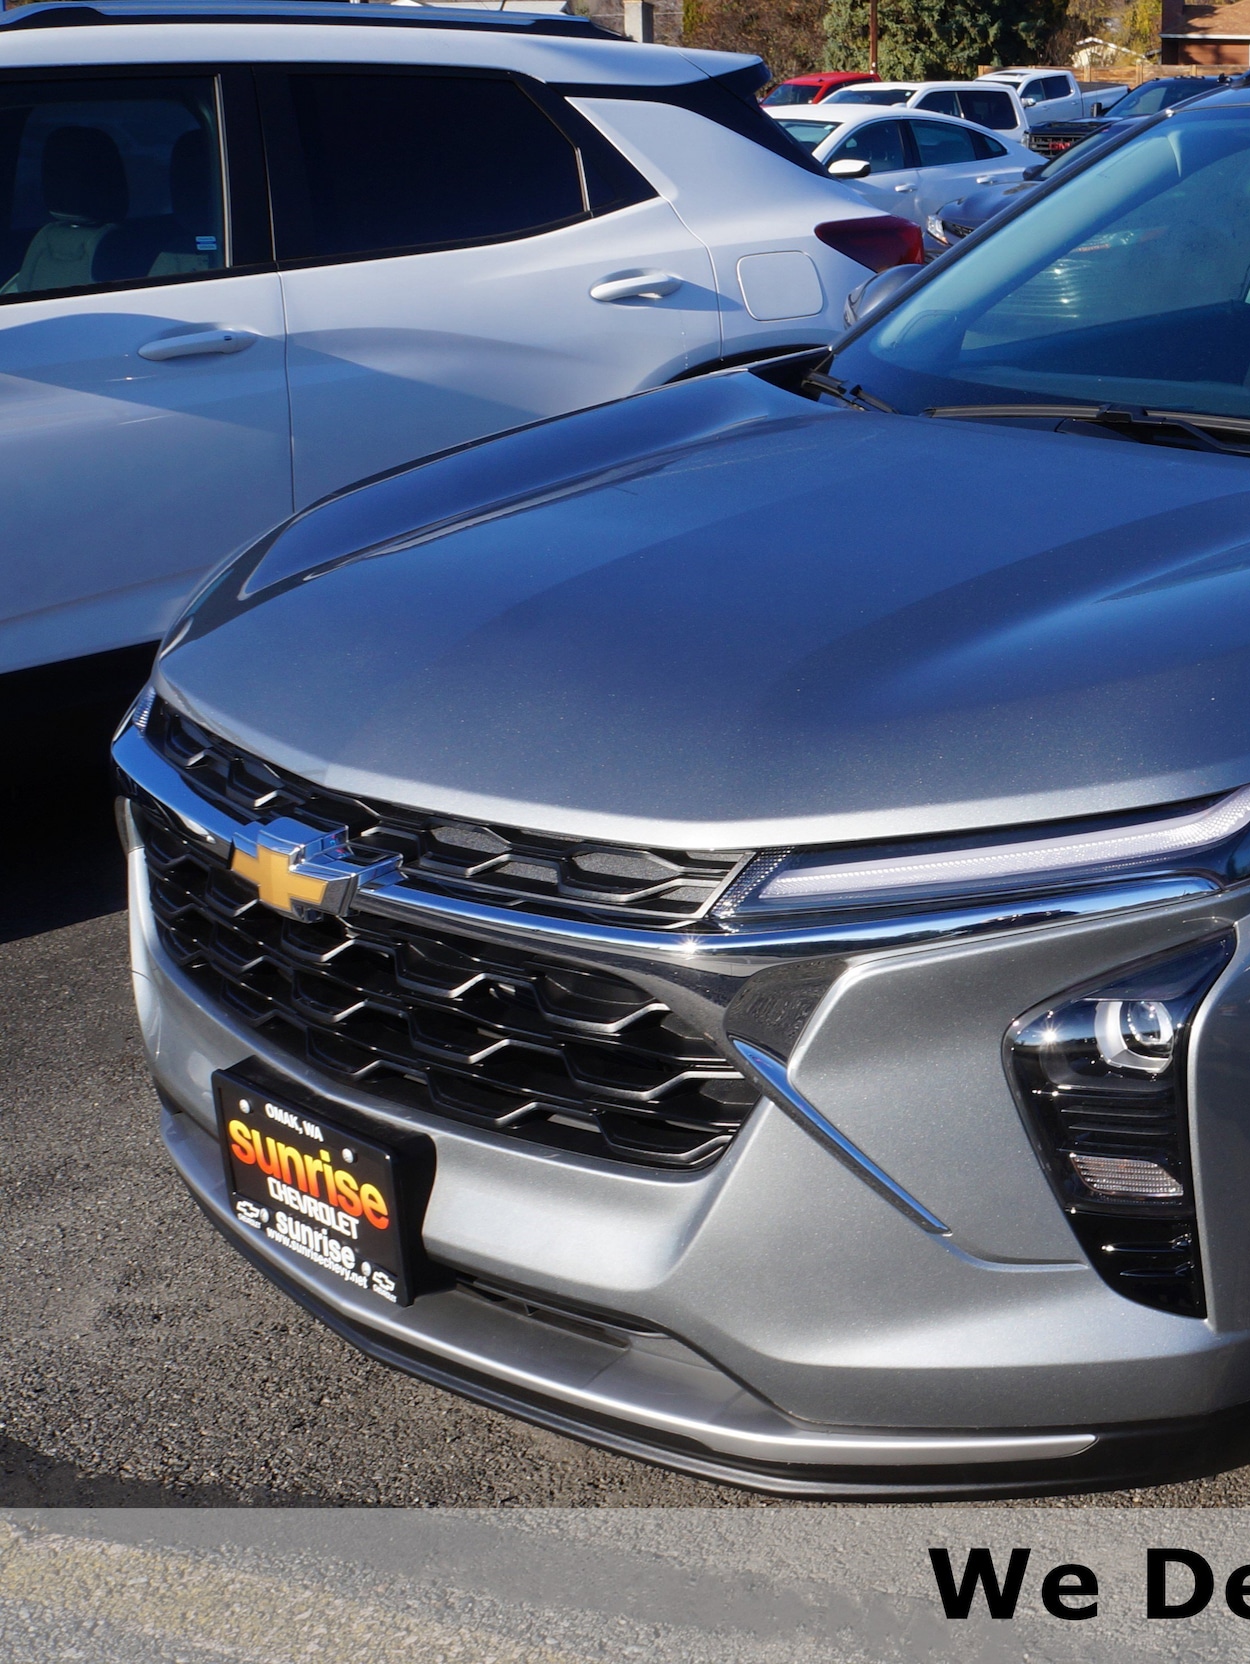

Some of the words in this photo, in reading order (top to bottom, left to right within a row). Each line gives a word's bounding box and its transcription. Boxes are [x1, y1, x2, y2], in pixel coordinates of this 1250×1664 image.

[265, 1103, 304, 1135] OMAK,
[303, 1122, 324, 1142] WA
[267, 1176, 359, 1240] CHEVROLET
[266, 1226, 369, 1289] www.sunrisechevy.net
